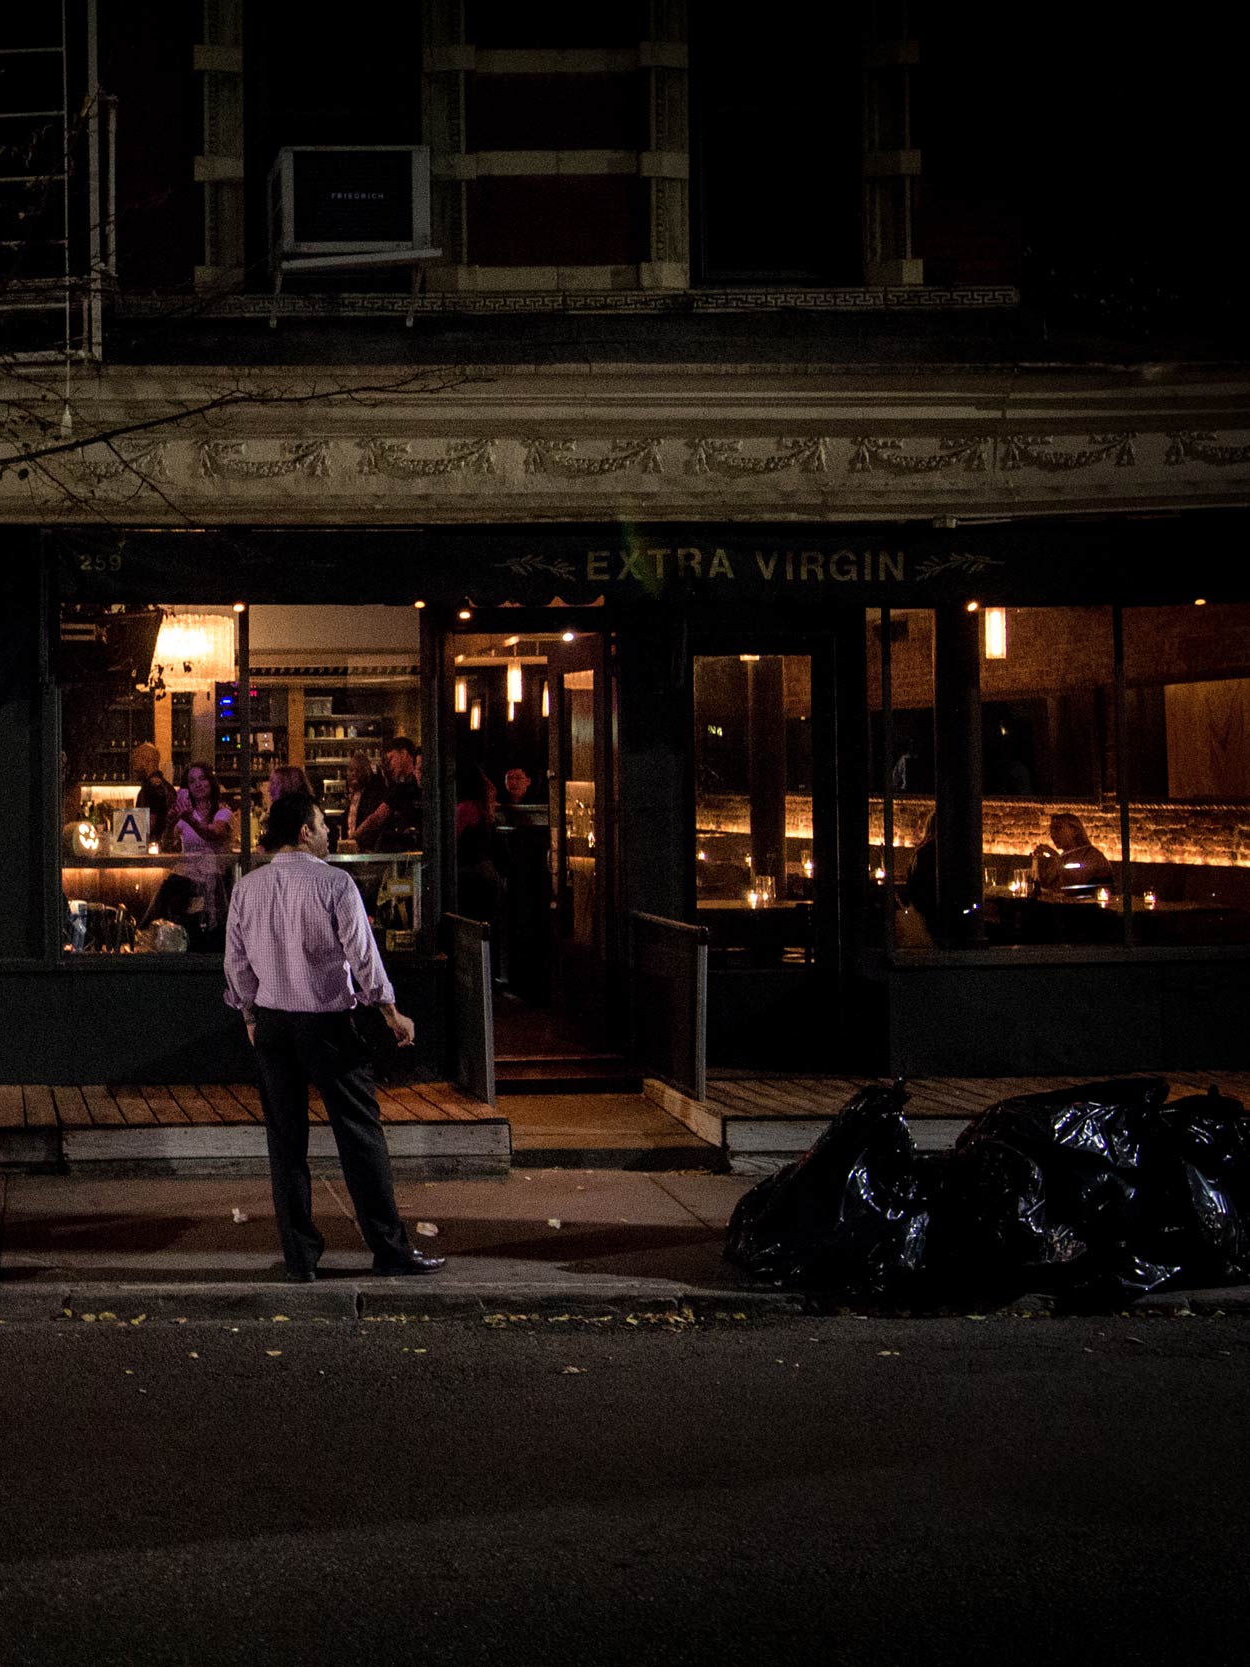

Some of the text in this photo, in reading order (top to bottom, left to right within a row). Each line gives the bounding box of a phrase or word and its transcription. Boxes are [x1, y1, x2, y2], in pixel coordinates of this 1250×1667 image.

[330, 192, 384, 200] FRIEDRICH
[79, 553, 122, 572] 259
[586, 548, 906, 582] EXTRA VIRGIN
[116, 814, 143, 842] A
